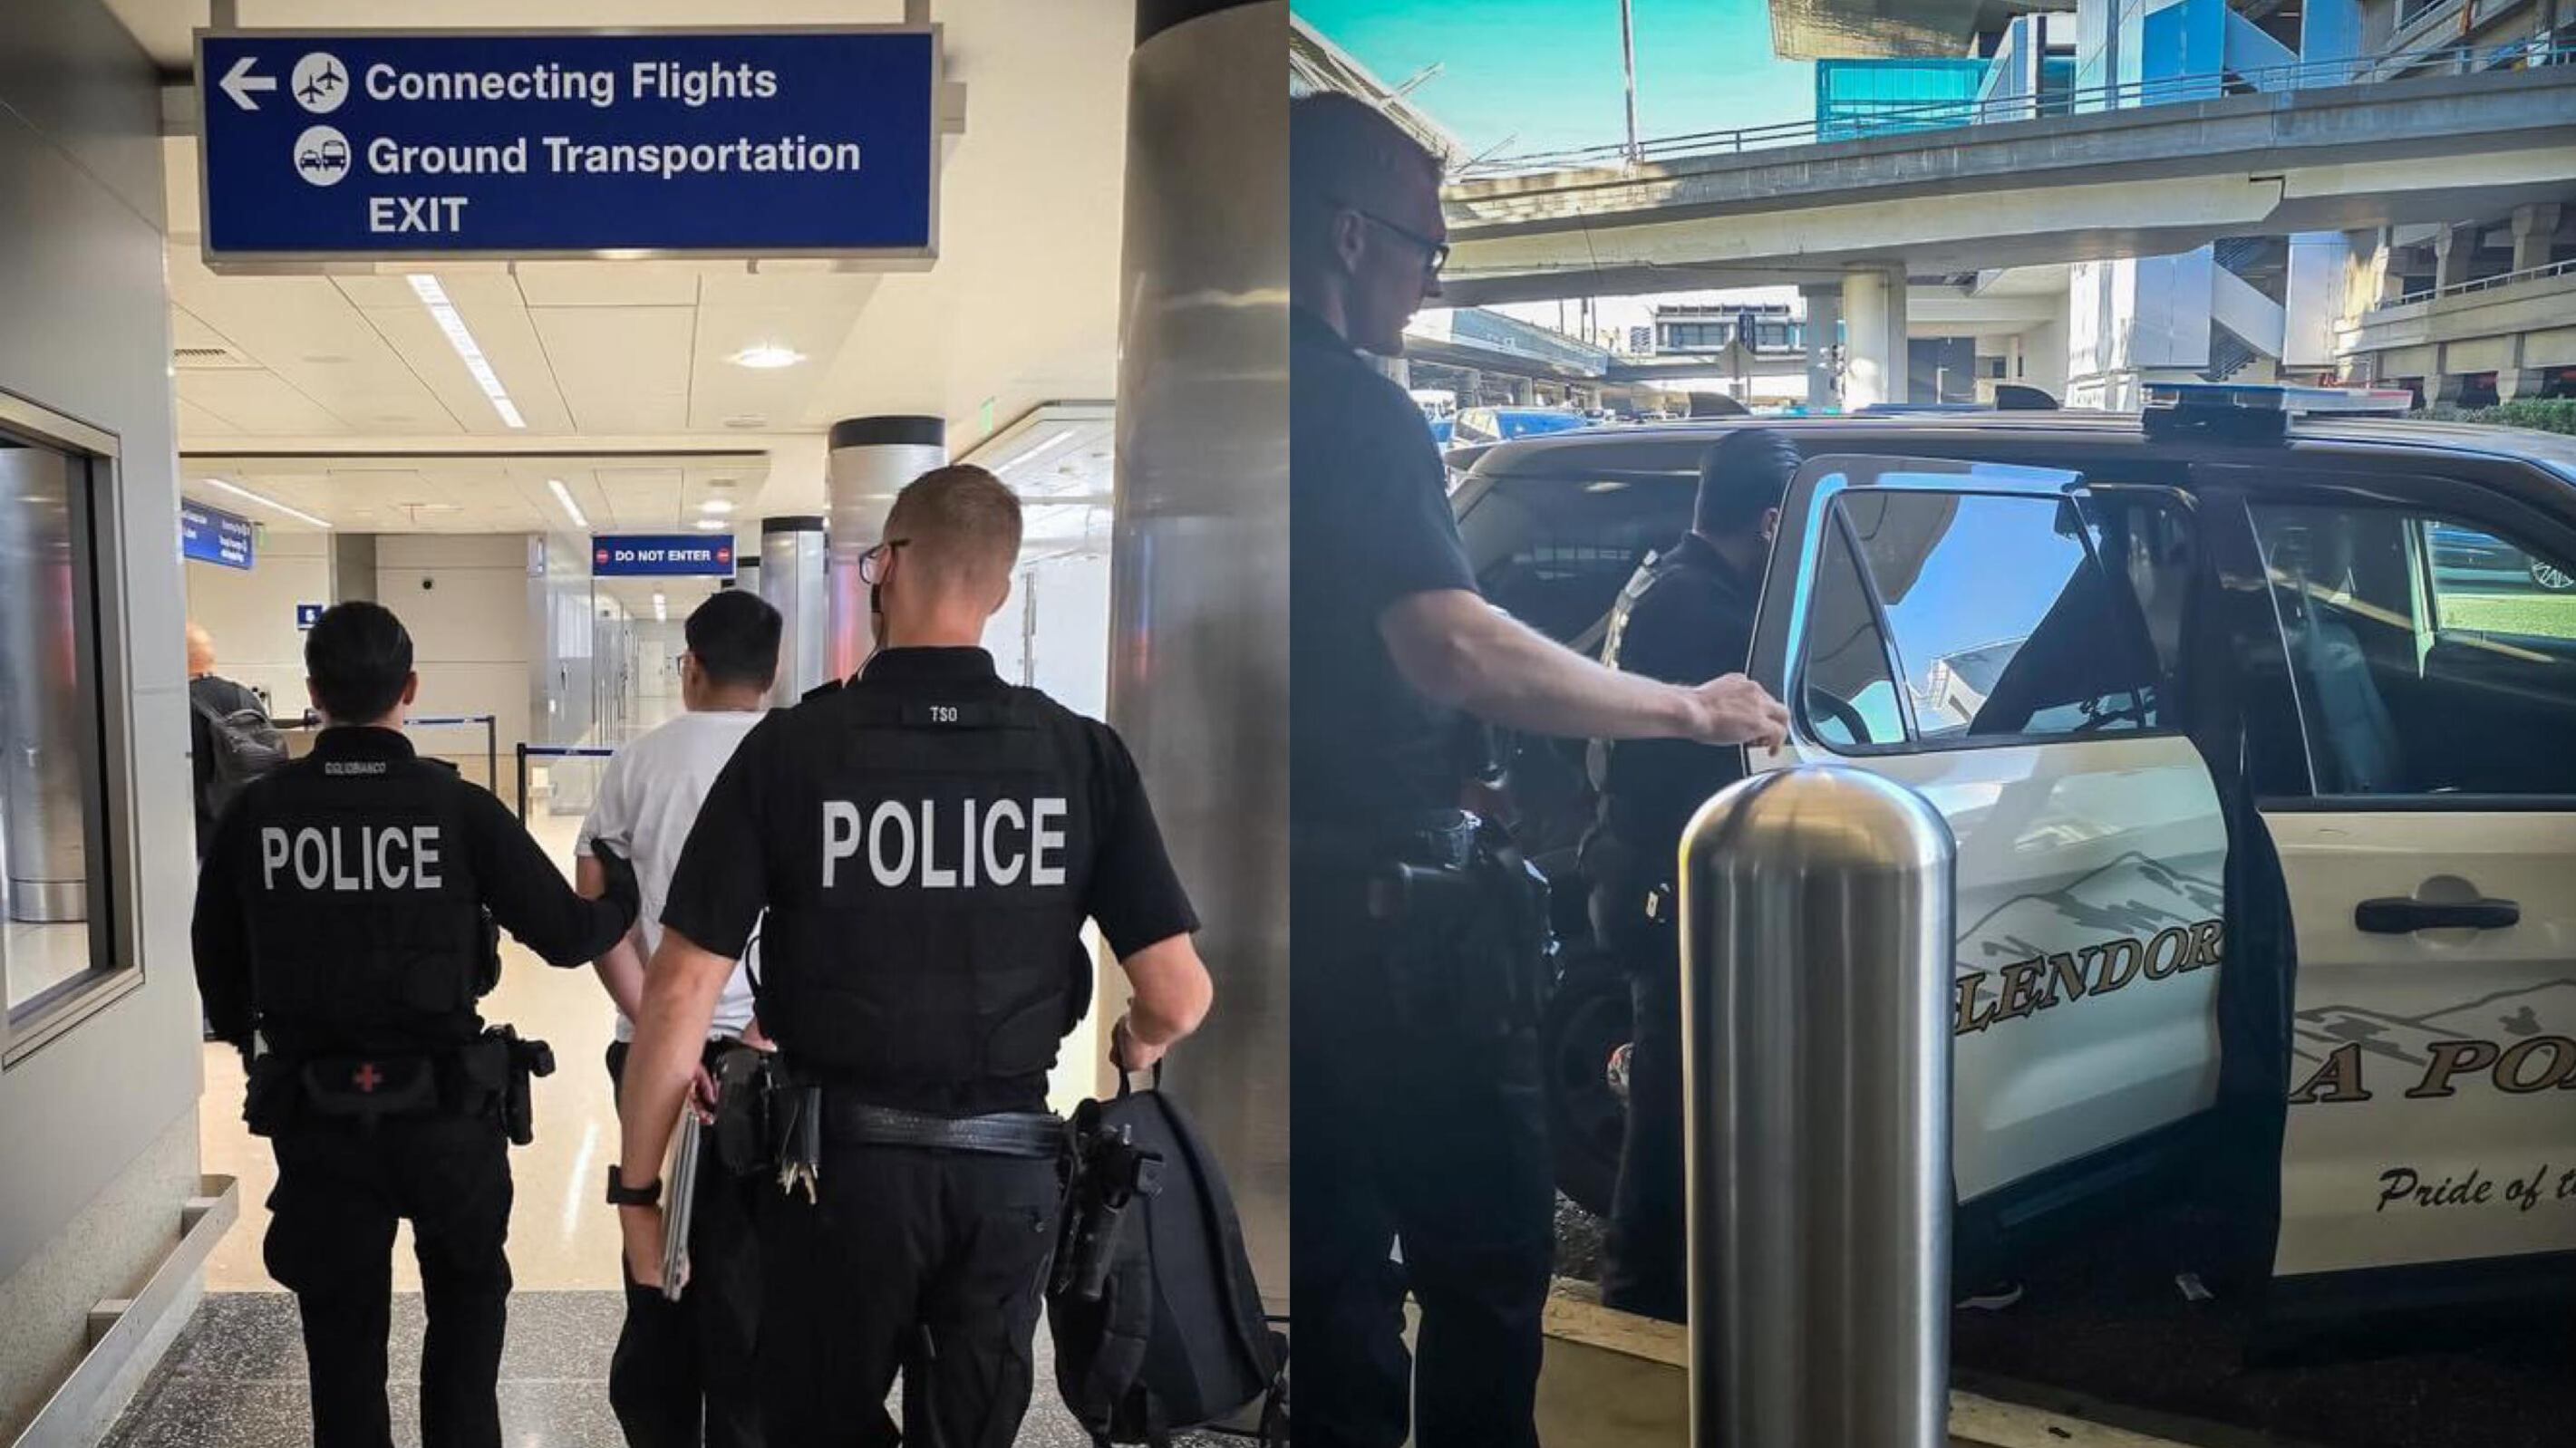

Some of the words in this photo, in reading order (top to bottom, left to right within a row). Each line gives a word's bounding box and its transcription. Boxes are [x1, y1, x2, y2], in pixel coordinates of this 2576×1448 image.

[365, 63, 615, 108] Connecting
[633, 62, 777, 107] Flights
[368, 137, 527, 174] Ground
[542, 135, 860, 179] Transportation
[369, 197, 468, 232] EXIT
[615, 550, 634, 561] DO
[638, 550, 664, 561] NOT
[668, 550, 711, 561] ENTER
[929, 705, 958, 722] TSO
[262, 826, 442, 891] POLICE
[822, 797, 1067, 888] POLICE
[1954, 919, 2223, 1036] LENDOR
[2288, 1041, 2373, 1104] A
[2404, 1036, 2576, 1099] PO
[2376, 1167, 2492, 1212] Pride
[2504, 1163, 2548, 1211] of
